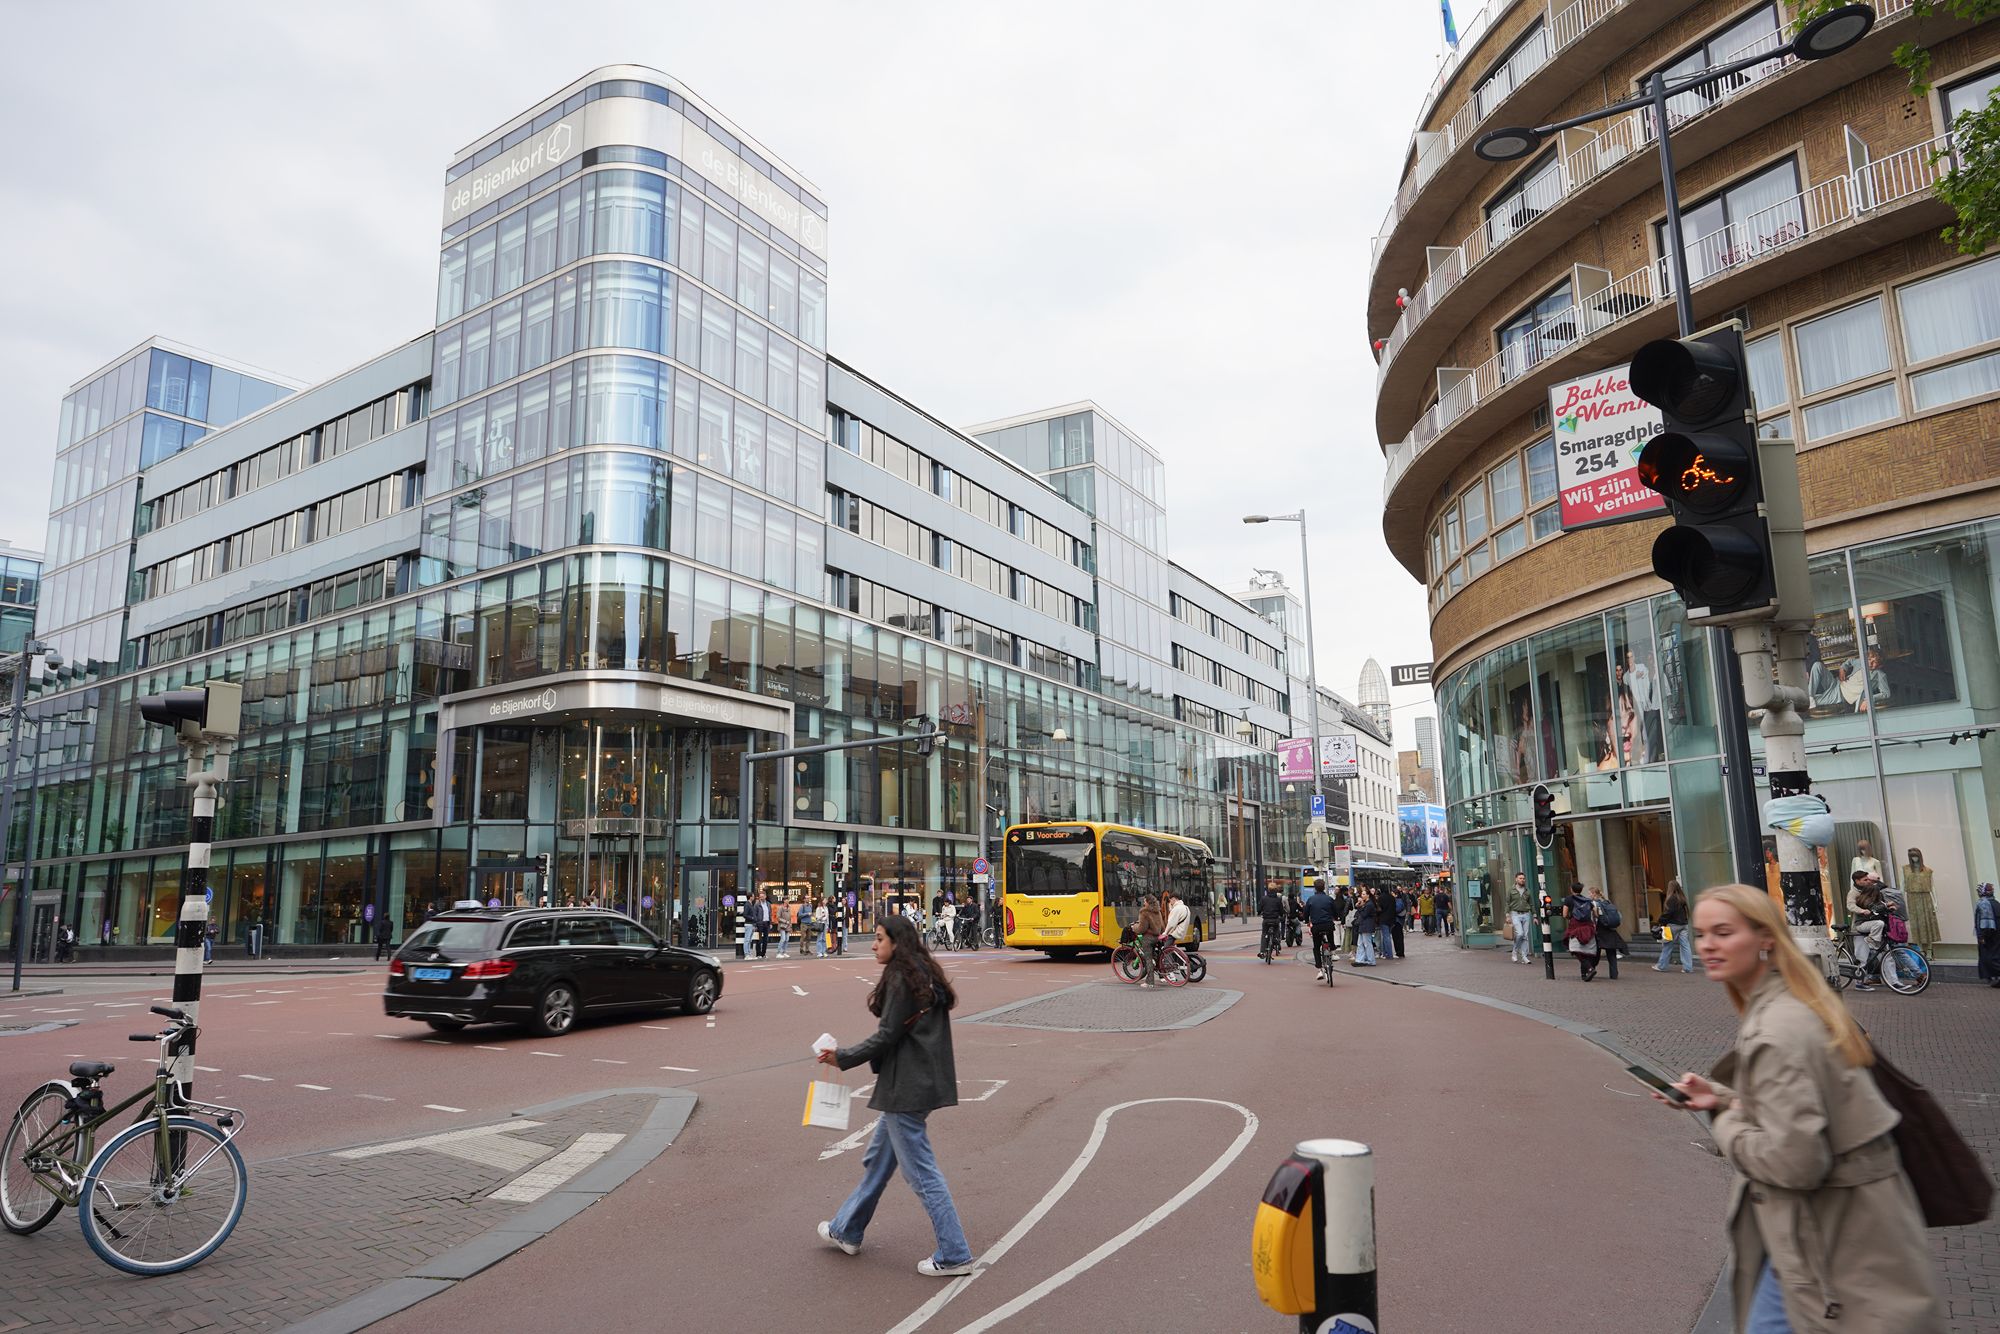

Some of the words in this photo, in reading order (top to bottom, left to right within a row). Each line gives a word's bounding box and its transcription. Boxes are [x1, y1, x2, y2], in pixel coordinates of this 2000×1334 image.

[451, 189, 471, 212] de
[471, 142, 545, 202] Bijenkorf
[701, 149, 724, 177] de
[726, 161, 799, 230] Bijenkorf
[1556, 376, 1631, 416] Bakke
[1559, 421, 1665, 456] Smaragdple
[1575, 450, 1619, 476] 254
[1564, 486, 1594, 507] Wij
[1598, 477, 1631, 496] zijn
[1398, 665, 1430, 682] WE
[766, 681, 789, 693] kitchen
[489, 702, 501, 716] de
[501, 694, 542, 715] Bijenkorf
[660, 694, 674, 706] de
[676, 695, 719, 714] Bijenkorf
[1313, 796, 1322, 809] P
